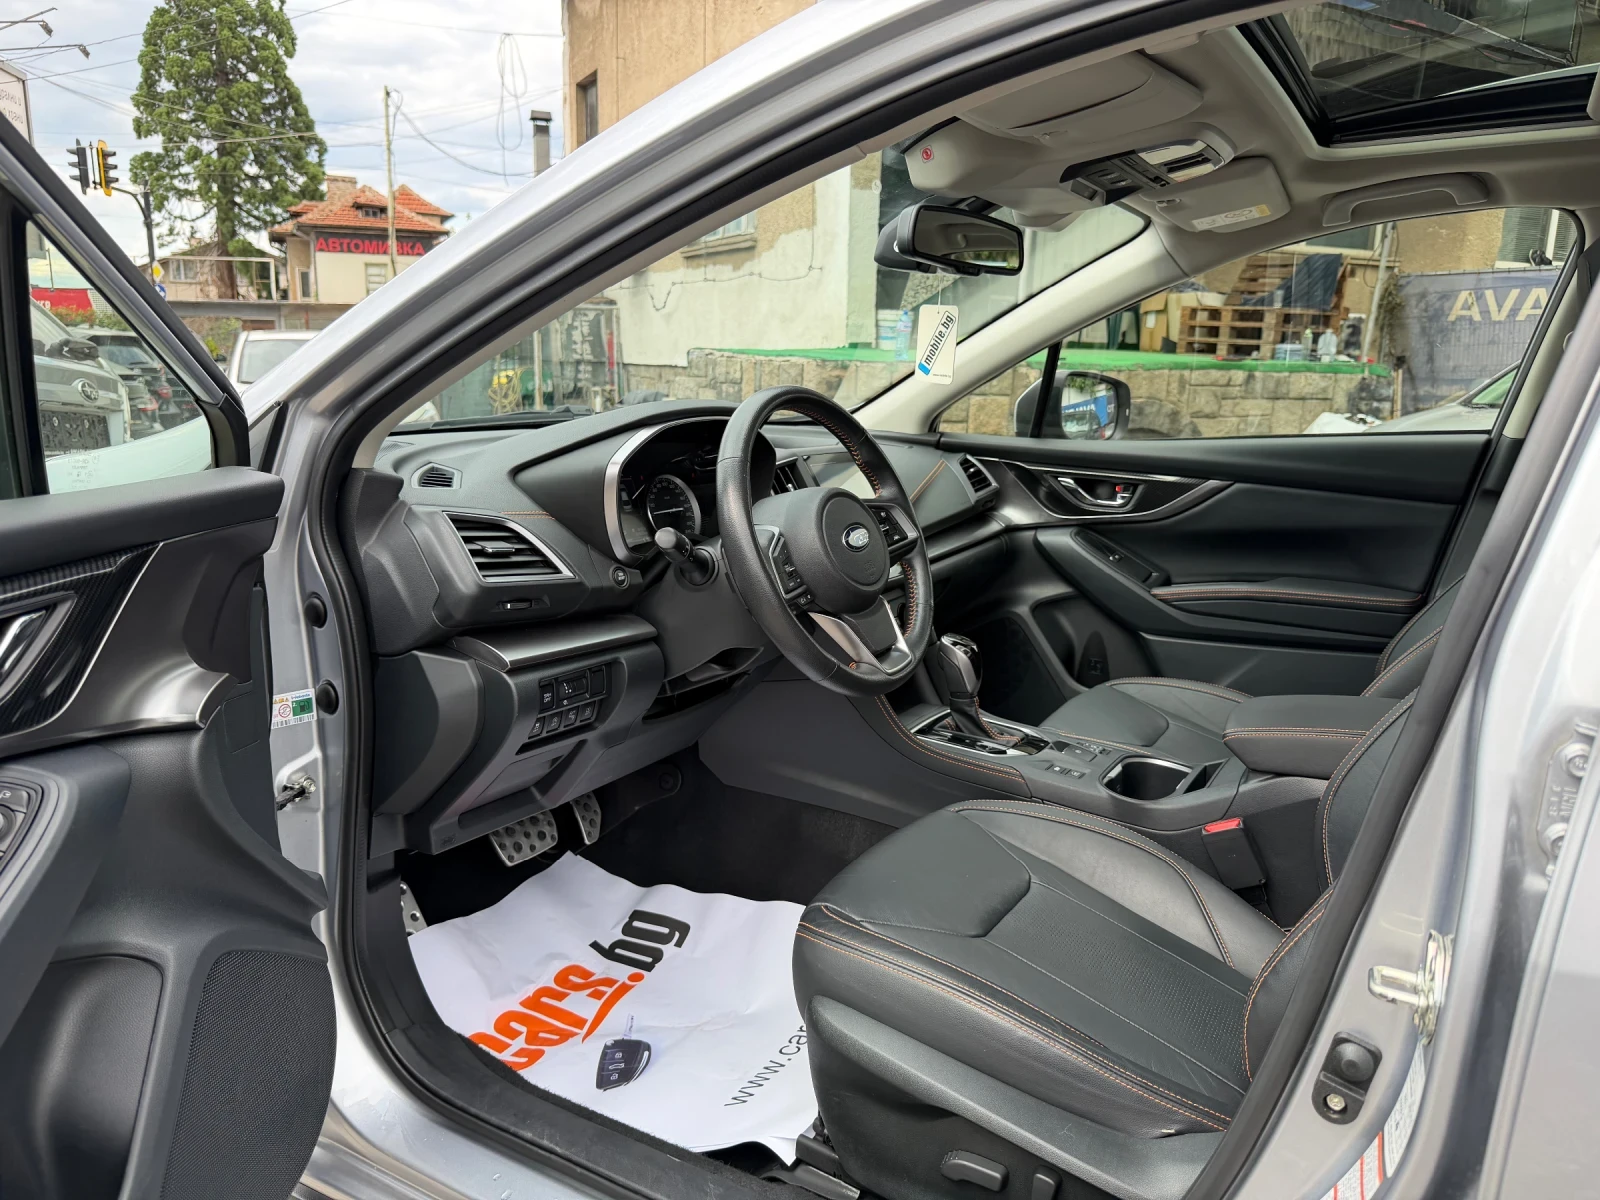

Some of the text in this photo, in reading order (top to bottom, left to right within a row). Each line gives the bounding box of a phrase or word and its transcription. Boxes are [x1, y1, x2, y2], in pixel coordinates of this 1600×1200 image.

[315, 237, 425, 256] АВТОМИВКА
[1447, 287, 1549, 322] AVA
[924, 314, 954, 367] mobile.bg
